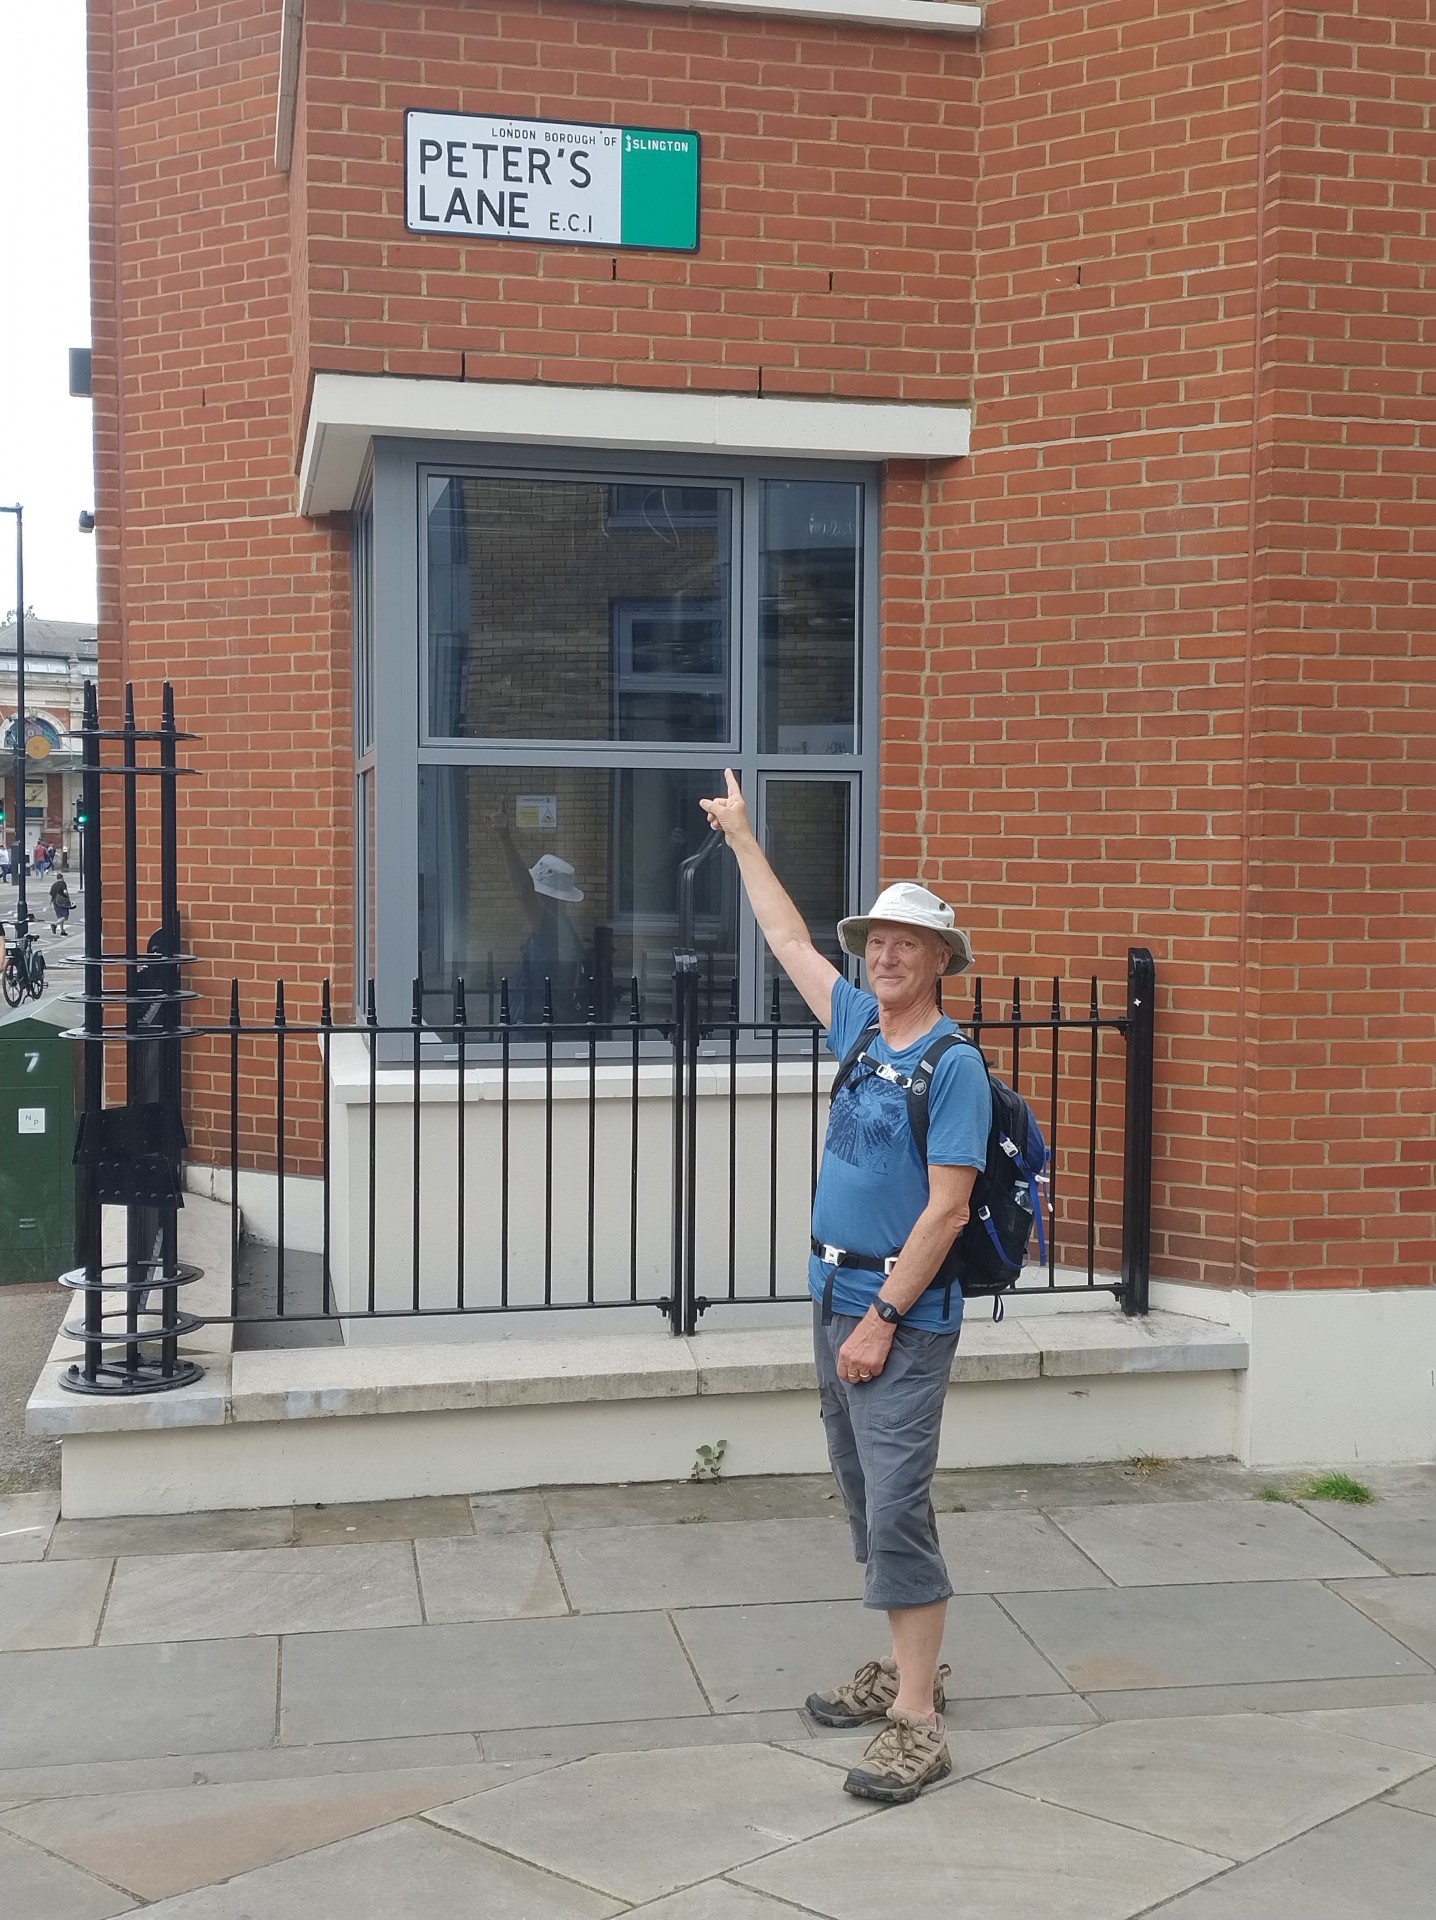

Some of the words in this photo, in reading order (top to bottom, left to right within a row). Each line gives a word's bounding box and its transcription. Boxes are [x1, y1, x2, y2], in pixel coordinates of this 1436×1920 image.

[491, 127, 537, 140] LONDON
[544, 132, 596, 145] BOROUGH
[603, 137, 618, 147] OF
[419, 138, 592, 189] PETER'S
[419, 184, 530, 229] LANE
[24, 1052, 40, 1073] 7
